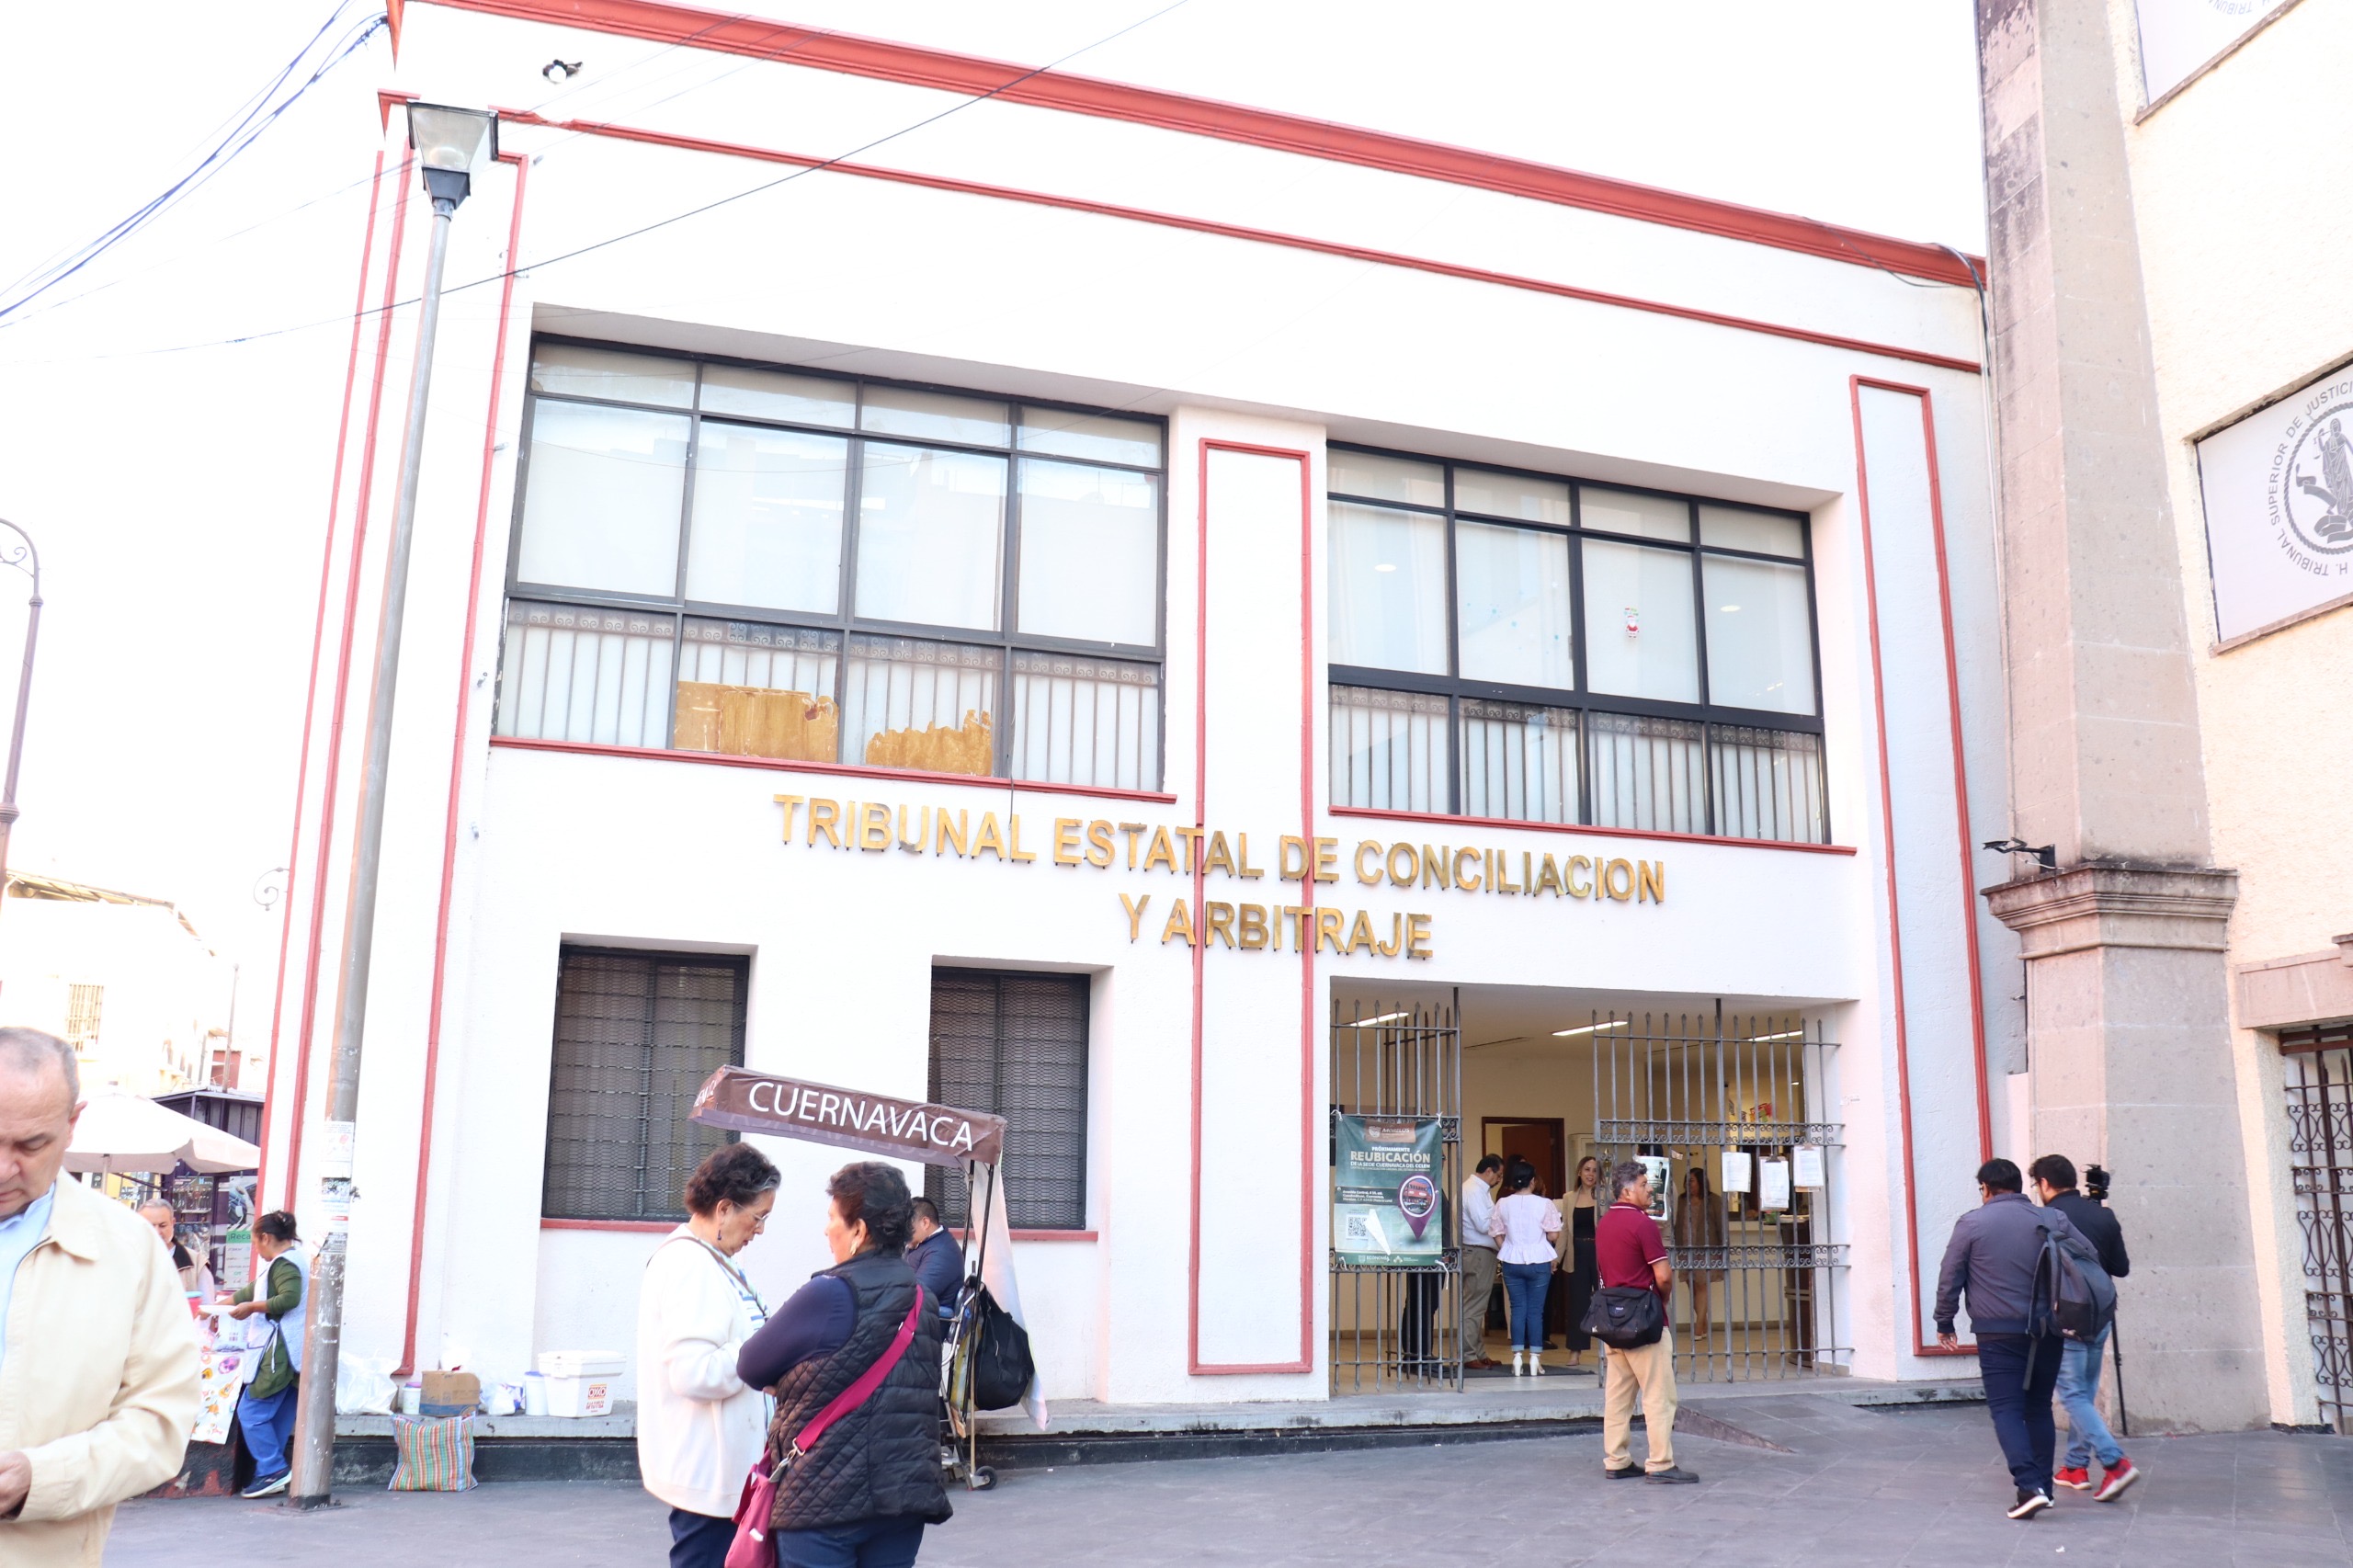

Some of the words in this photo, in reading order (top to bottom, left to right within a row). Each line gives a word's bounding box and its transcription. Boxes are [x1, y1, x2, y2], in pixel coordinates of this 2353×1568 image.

[2286, 418, 2303, 439] DE
[2268, 443, 2289, 526] SUPERIOR
[2277, 528, 2329, 576] TRIBUNAL
[773, 794, 1037, 862] TRIBUNAL
[1053, 817, 1265, 880] ESTATAL
[1279, 835, 1340, 882] DE
[1354, 838, 1665, 903] CONCILIACION
[1119, 892, 1151, 942] Y
[1161, 897, 1433, 958] ARBITRAJE
[748, 1081, 974, 1152] CUERNAVACA
[1350, 1150, 1431, 1164] REUBICACIÓN
[588, 1387, 607, 1397] OXXO
